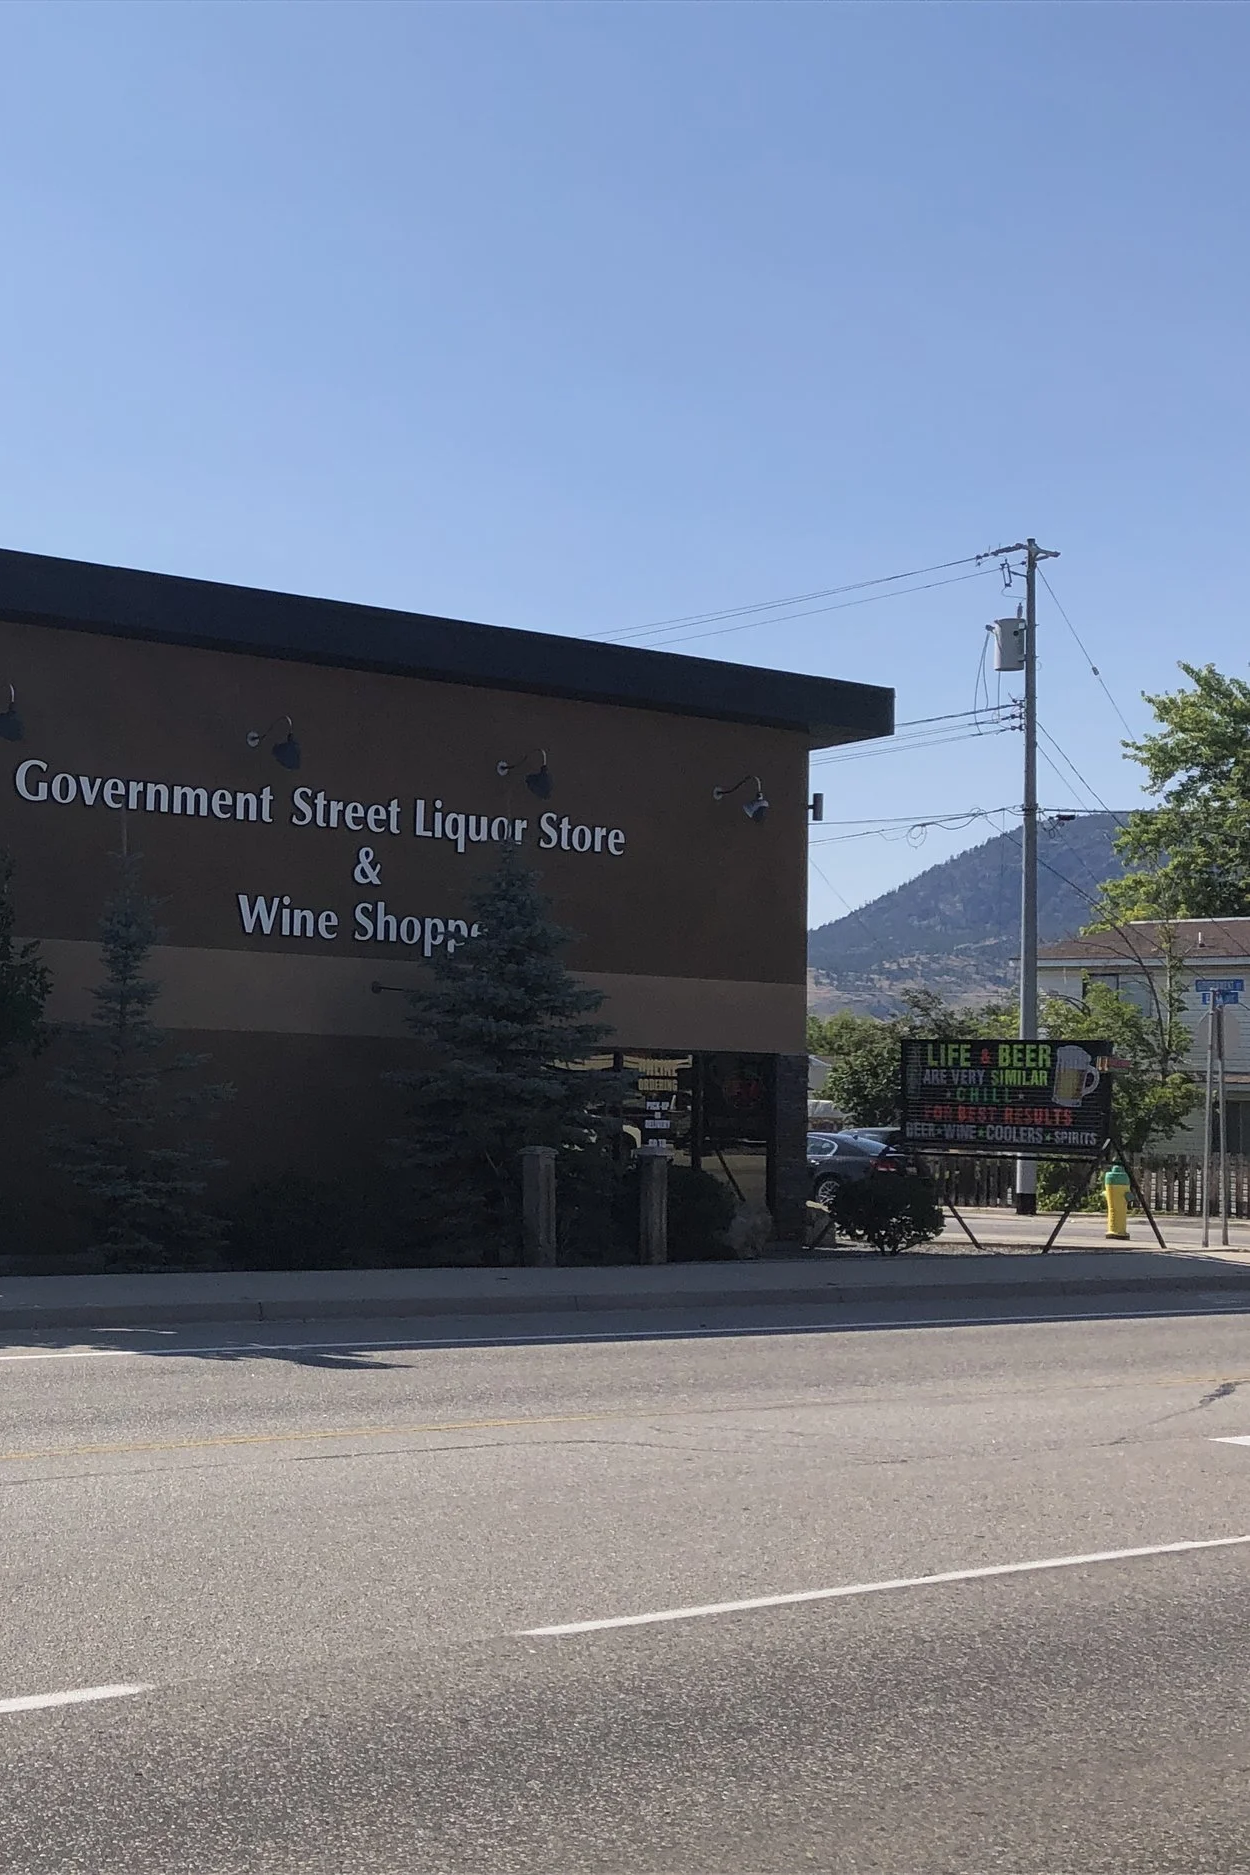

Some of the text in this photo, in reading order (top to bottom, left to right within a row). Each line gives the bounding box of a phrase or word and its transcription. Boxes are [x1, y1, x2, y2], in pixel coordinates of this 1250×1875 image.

[14, 758, 626, 856] Government Street Liquor Store
[353, 846, 382, 886] &
[237, 893, 339, 940] Wine
[927, 1043, 1051, 1068] LIFE & BEER
[637, 1078, 679, 1091] ORDERING
[922, 1069, 1048, 1087] ARE VERY SIMILAR
[646, 1101, 670, 1111] PICK-UP
[956, 1086, 1012, 1104] CHILL
[644, 1119, 671, 1129] DELIVERY
[957, 1105, 998, 1123] BEST
[1004, 1106, 1074, 1127] RESULTS
[943, 1123, 977, 1140] WINE
[986, 1124, 1044, 1144] COOLERS
[1054, 1130, 1098, 1146] SPIRITS
